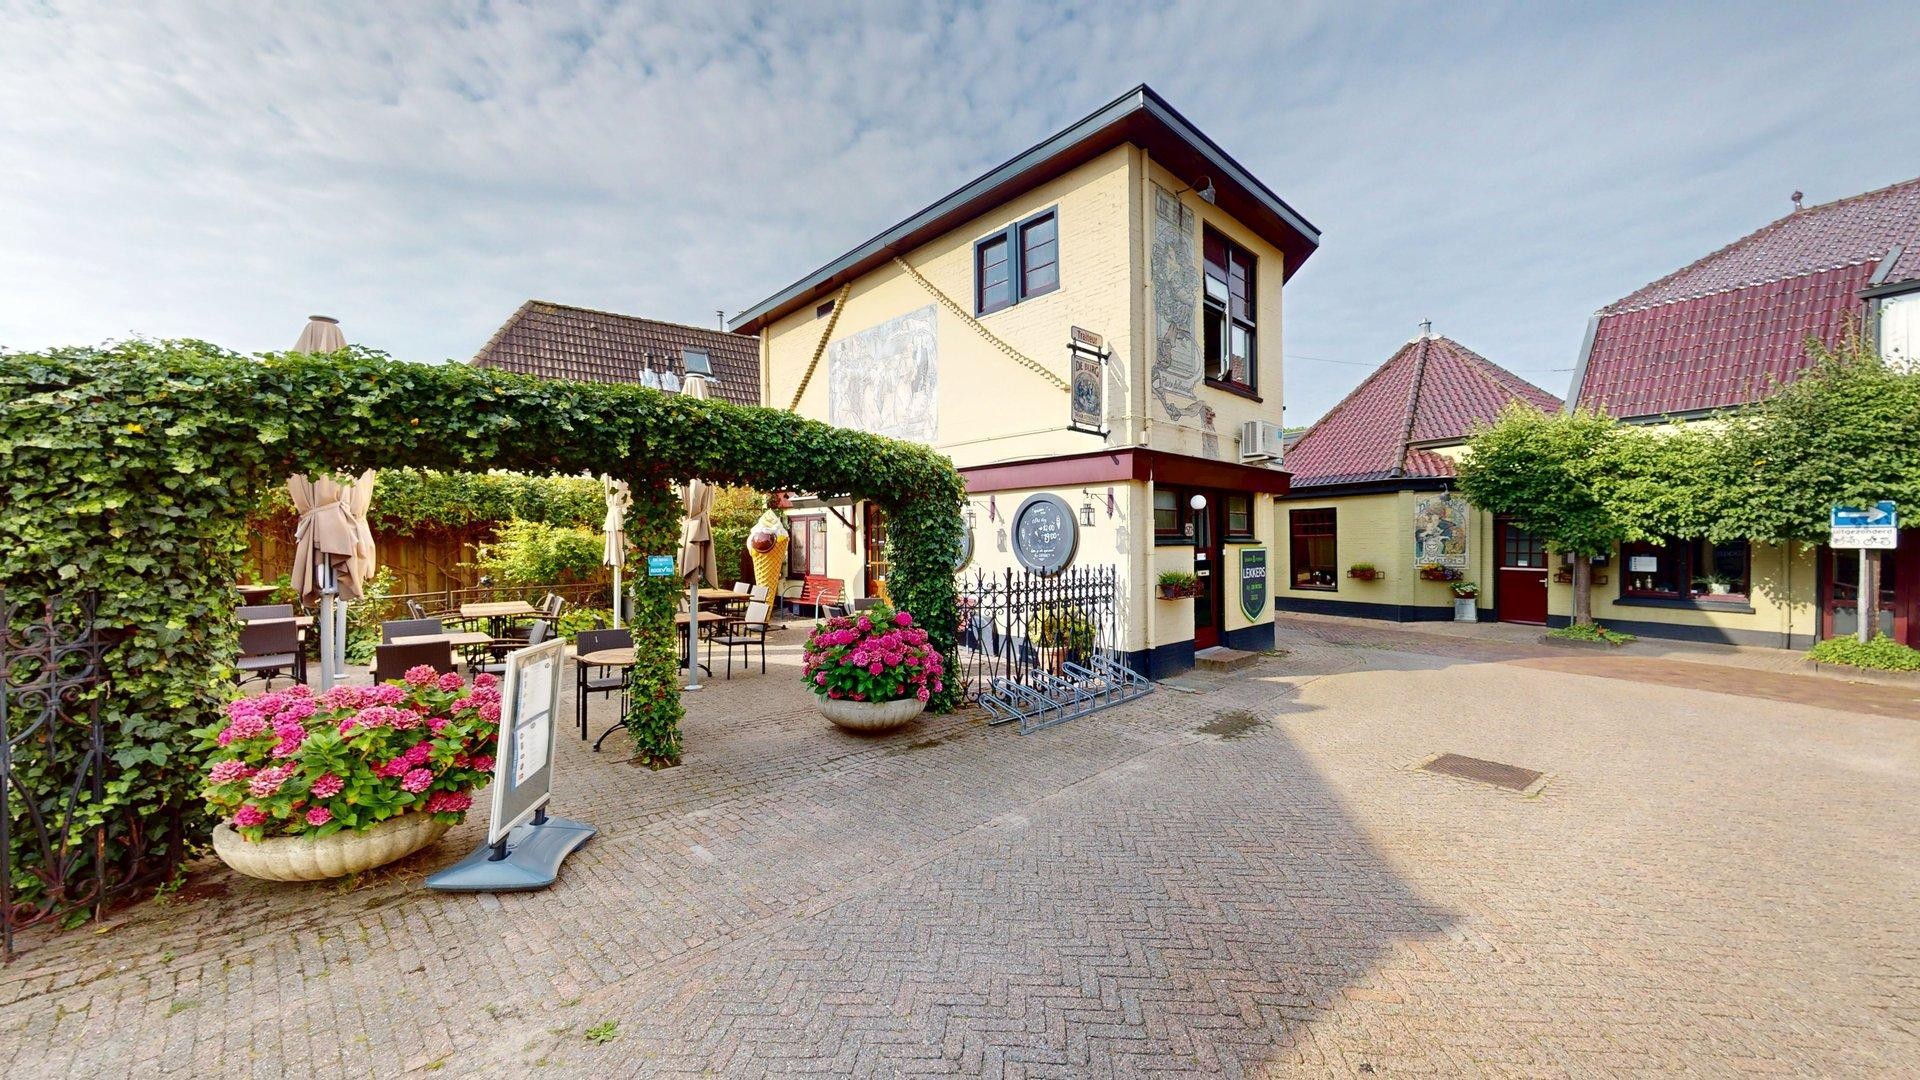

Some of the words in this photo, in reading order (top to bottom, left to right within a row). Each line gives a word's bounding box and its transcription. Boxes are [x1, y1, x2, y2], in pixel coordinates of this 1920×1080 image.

[1077, 330, 1098, 344] Traiteur
[1075, 361, 1083, 371] DE
[1084, 363, 1099, 377] BURG
[1243, 567, 1266, 578] LEKKERS
